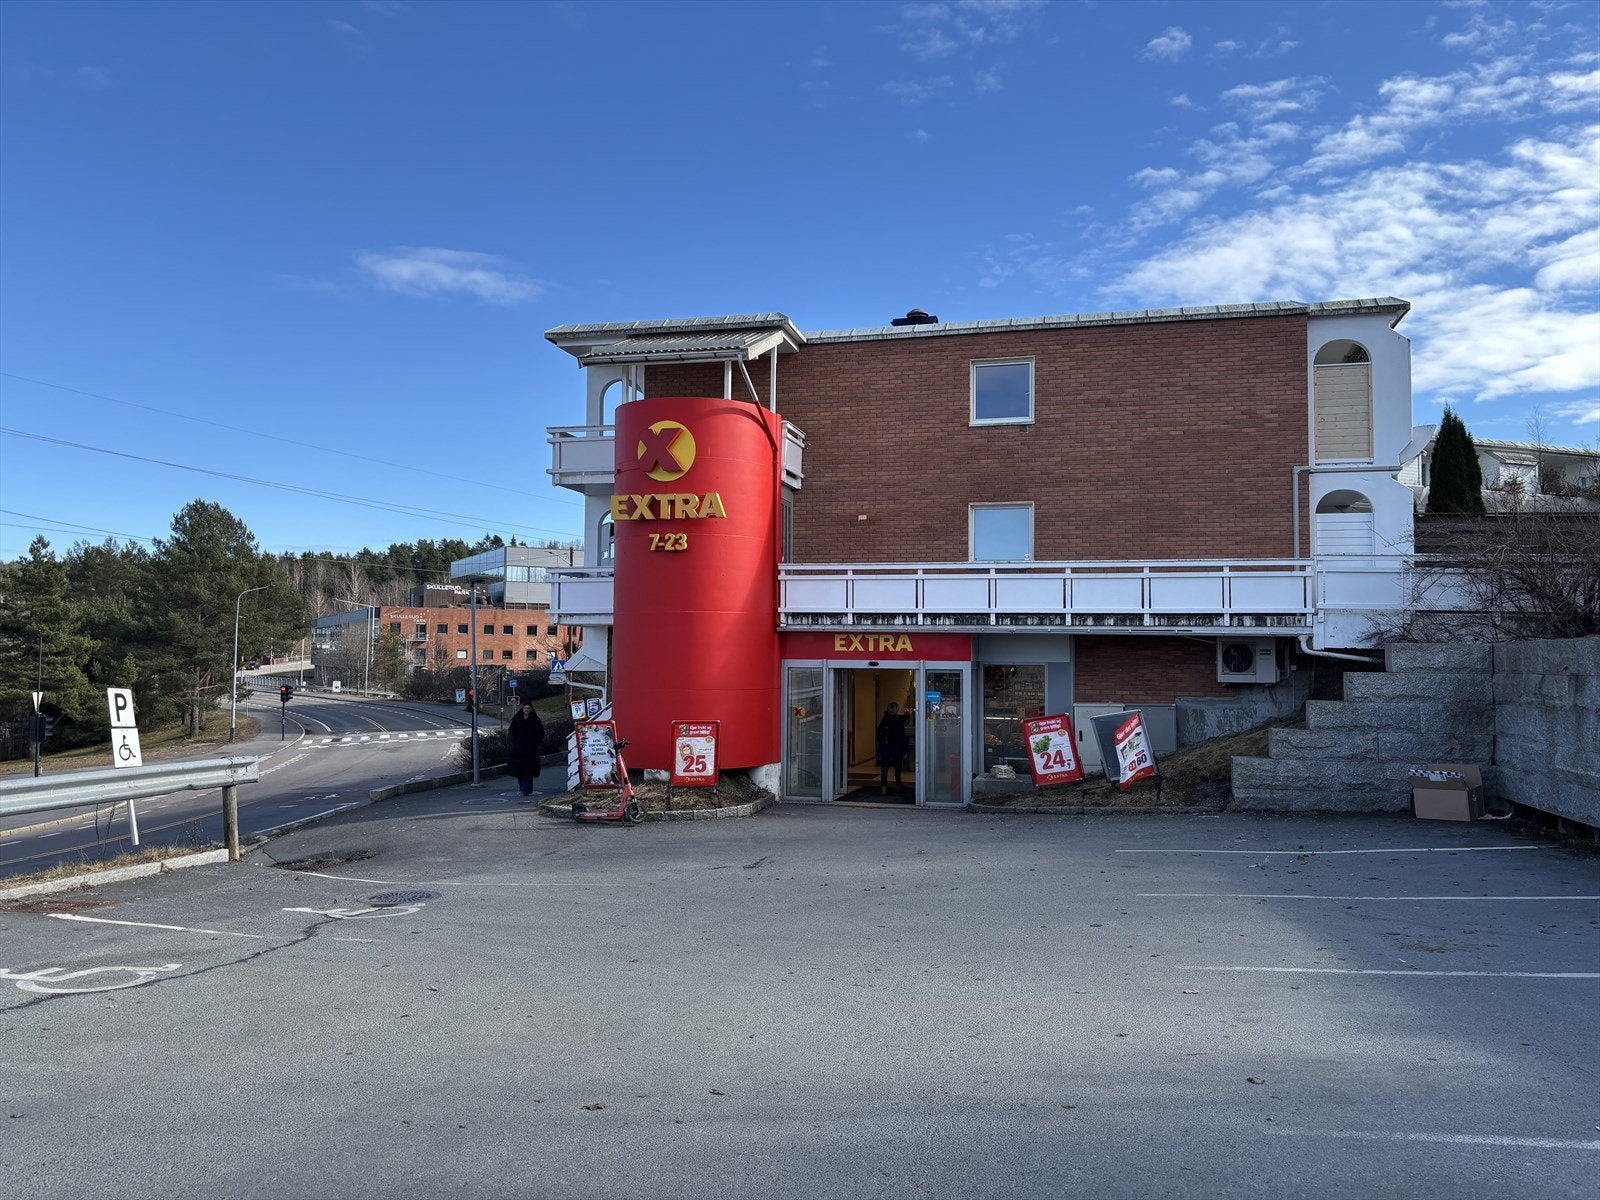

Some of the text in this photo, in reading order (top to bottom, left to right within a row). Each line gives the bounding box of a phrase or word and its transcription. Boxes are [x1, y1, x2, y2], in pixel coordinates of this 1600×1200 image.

[610, 492, 727, 521] EXTRA
[649, 533, 688, 551] 7-23
[834, 634, 913, 652] EXTRA
[114, 693, 127, 722] P
[683, 755, 707, 773] 25
